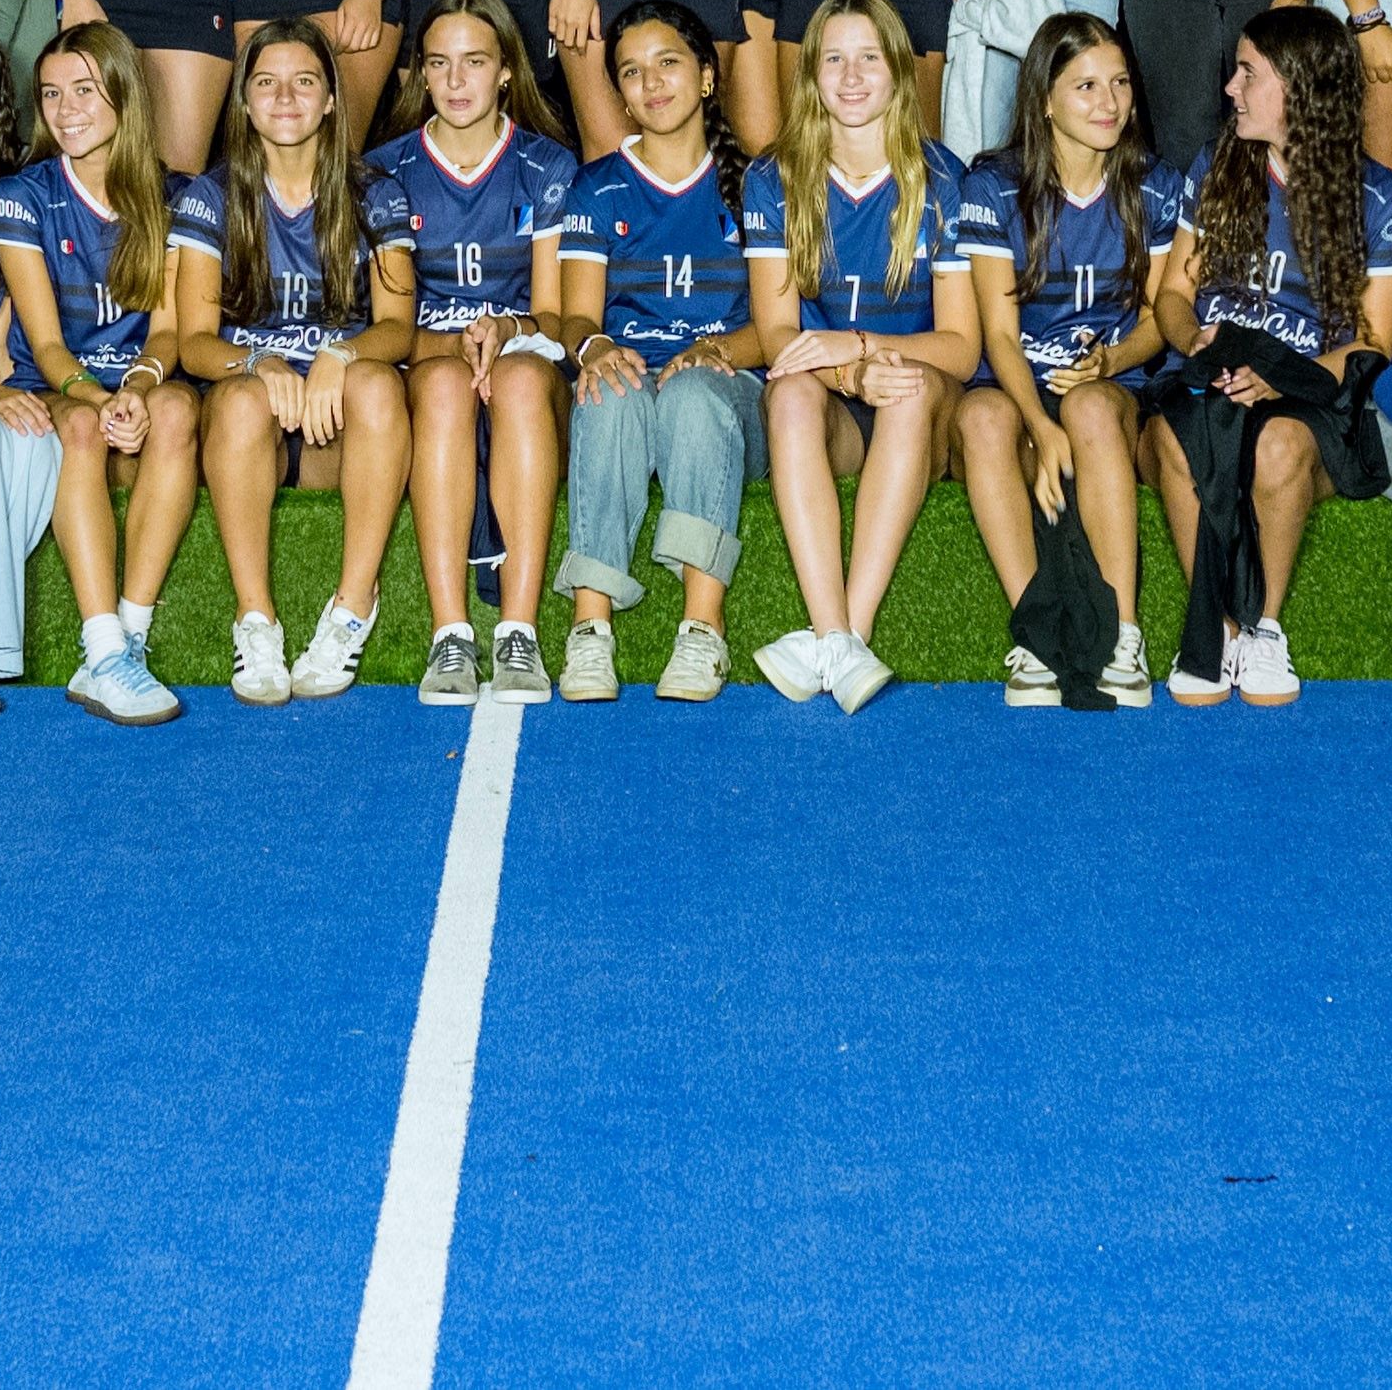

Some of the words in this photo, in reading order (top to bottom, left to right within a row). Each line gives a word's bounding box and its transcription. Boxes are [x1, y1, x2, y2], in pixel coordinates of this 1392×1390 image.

[454, 241, 482, 288] 16
[663, 253, 694, 298] 14
[1074, 264, 1095, 312] 11
[282, 271, 310, 322] 13
[844, 274, 861, 322] 7
